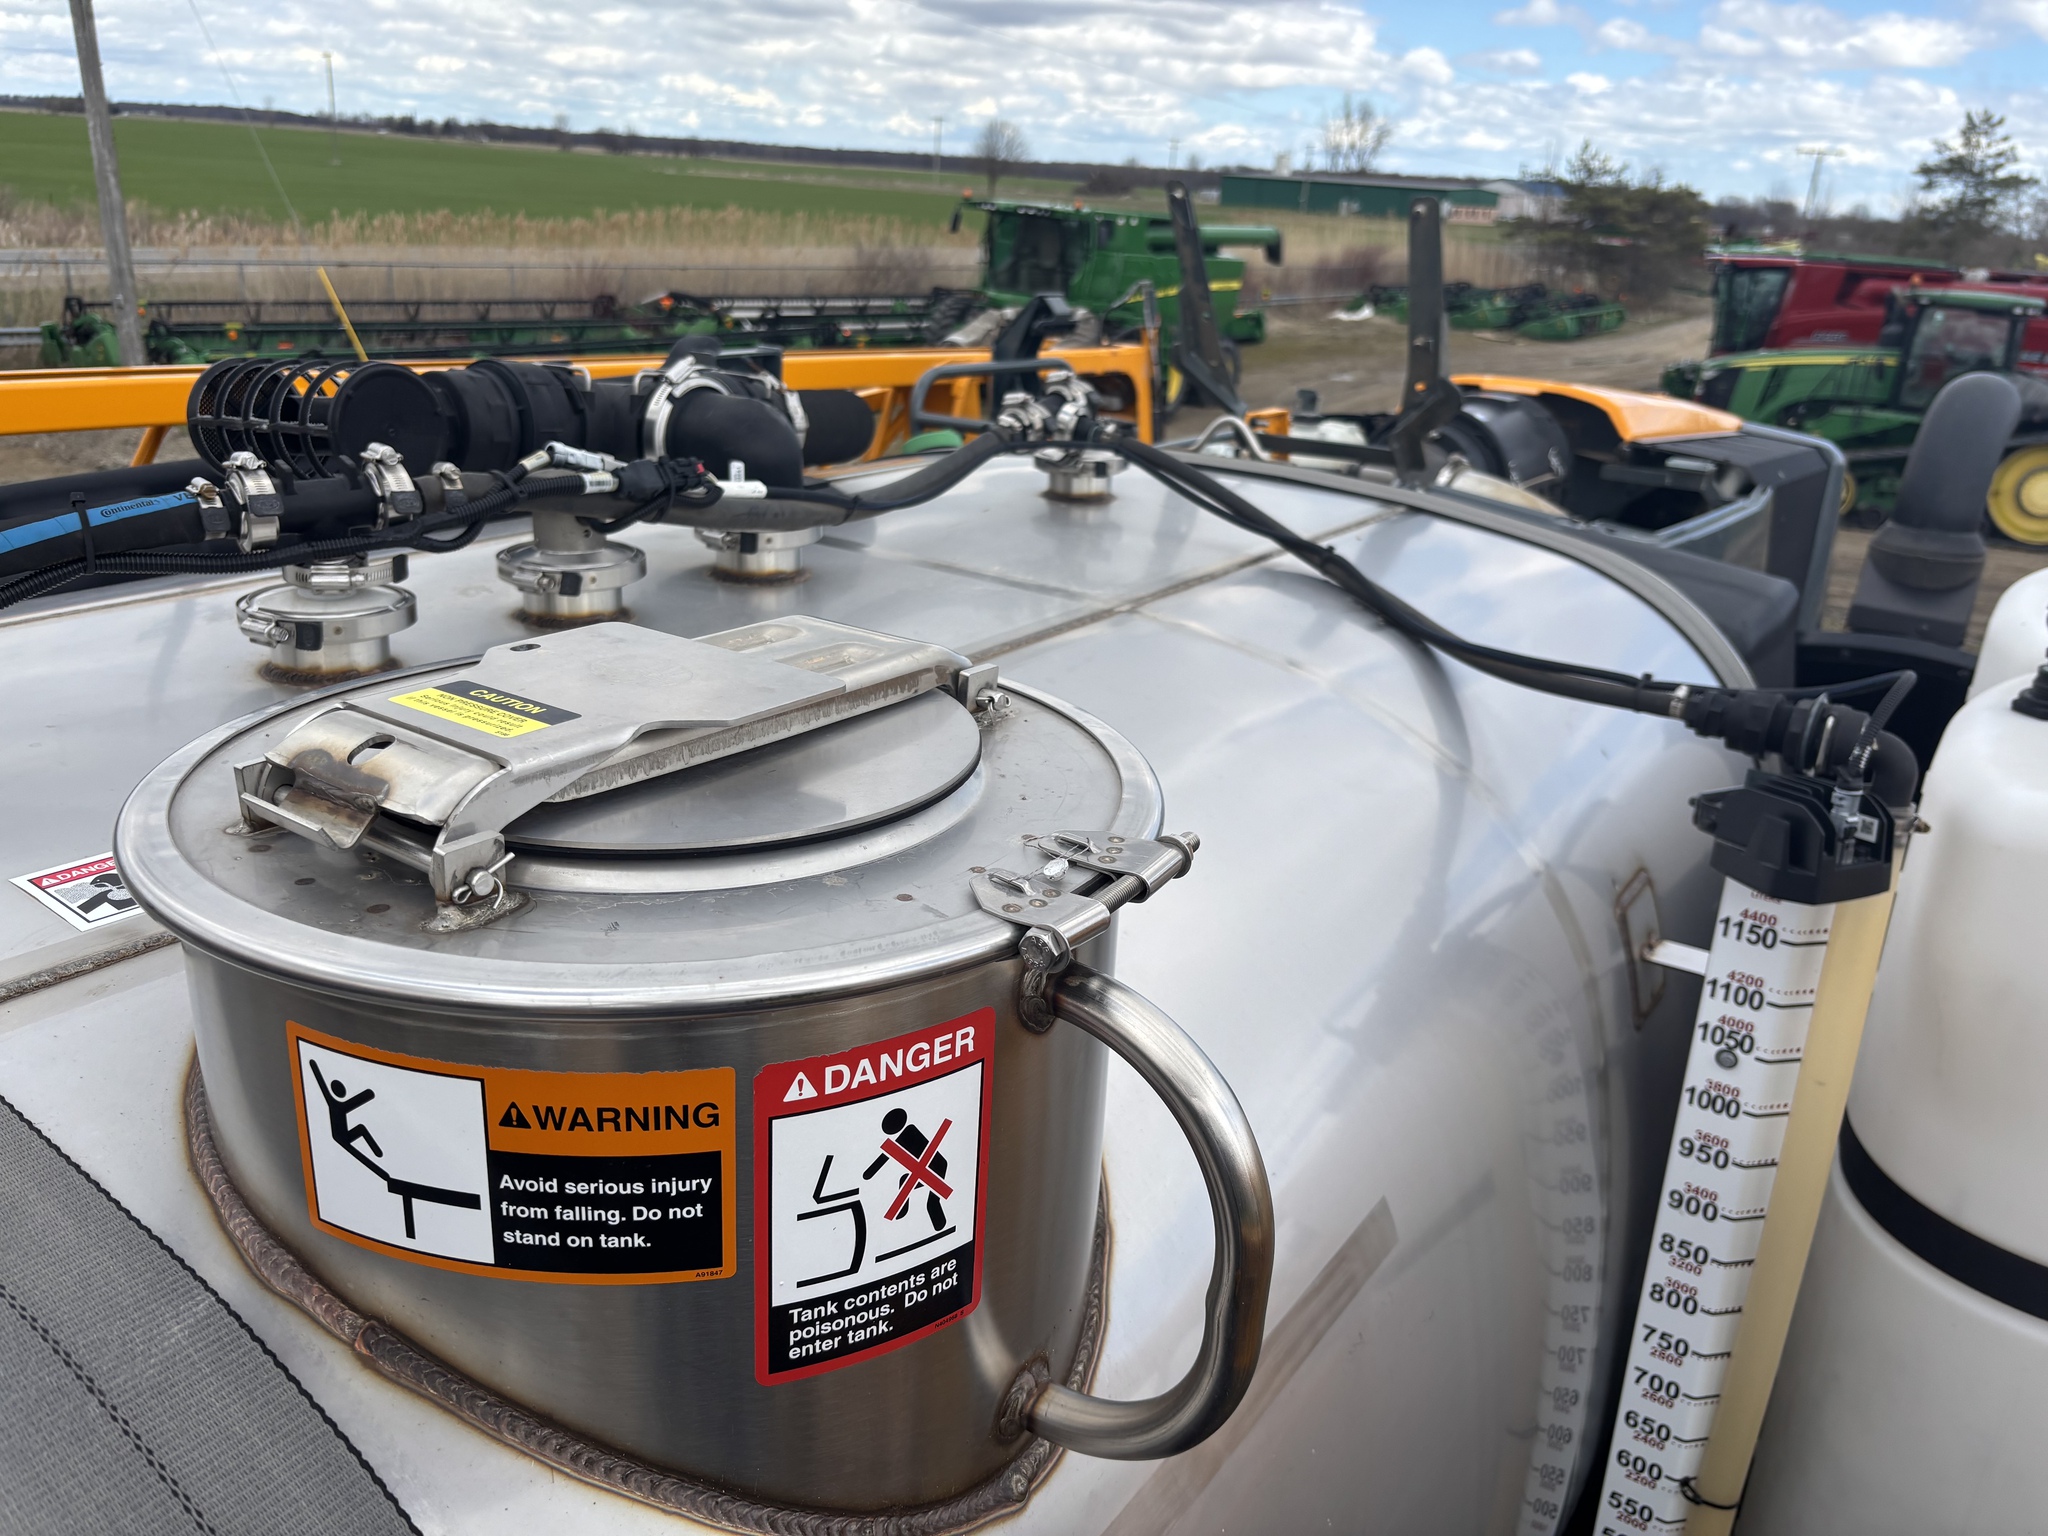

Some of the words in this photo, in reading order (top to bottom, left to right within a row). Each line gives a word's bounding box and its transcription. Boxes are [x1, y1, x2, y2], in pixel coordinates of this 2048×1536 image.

[100, 499, 155, 517] Continental
[457, 699, 499, 714] PRESSURE
[497, 711, 528, 723] COVER
[469, 690, 548, 714] CAUTION
[56, 860, 116, 880] DANGE
[1740, 908, 1777, 926] 4400
[1718, 916, 1778, 948] 1150
[1727, 970, 1764, 988] 4200
[1706, 978, 1764, 1010] 1100
[1718, 1014, 1754, 1033] 4000
[1698, 1022, 1754, 1054] 1050
[824, 1026, 975, 1096] DANGER
[1704, 1078, 1740, 1098] 3800
[1685, 1086, 1740, 1118] 1000
[532, 1102, 720, 1132] WARNING
[1694, 1130, 1730, 1149] 3600
[1678, 1137, 1730, 1170] 950
[499, 1174, 558, 1194] Avoid
[564, 1177, 645, 1195] serious
[651, 1175, 712, 1197] injury
[1684, 1182, 1719, 1202] 3400
[500, 1202, 549, 1220] from
[554, 1204, 626, 1224] falling.
[632, 1206, 662, 1222] Do
[668, 1203, 703, 1220] not
[1668, 1189, 1719, 1222] 900
[503, 1228, 561, 1247] stand
[566, 1234, 594, 1248] on
[598, 1232, 652, 1249] tank.
[1659, 1232, 1708, 1266] 850
[695, 1269, 724, 1278] A91847
[1668, 1256, 1702, 1276] 3200
[789, 1301, 839, 1325] Tank
[844, 1270, 925, 1312] contents
[930, 1258, 957, 1280] are
[1664, 1276, 1698, 1297] 3000
[789, 1305, 895, 1346] poisonous.
[904, 1288, 928, 1308] Do
[932, 1272, 958, 1298] not
[1650, 1283, 1698, 1316] 800
[788, 1336, 843, 1360] enter
[847, 1321, 894, 1346] tank.
[1642, 1324, 1689, 1358] 750
[1650, 1346, 1683, 1367] 2800
[1634, 1366, 1680, 1400] 700
[1641, 1388, 1674, 1409] 2600
[1624, 1409, 1670, 1442] 650
[1632, 1430, 1665, 1451] 2400
[1616, 1449, 1662, 1482] 600
[1625, 1469, 1657, 1490] 2200
[1608, 1490, 1653, 1523] 550
[1616, 1511, 1648, 1531] 2000
